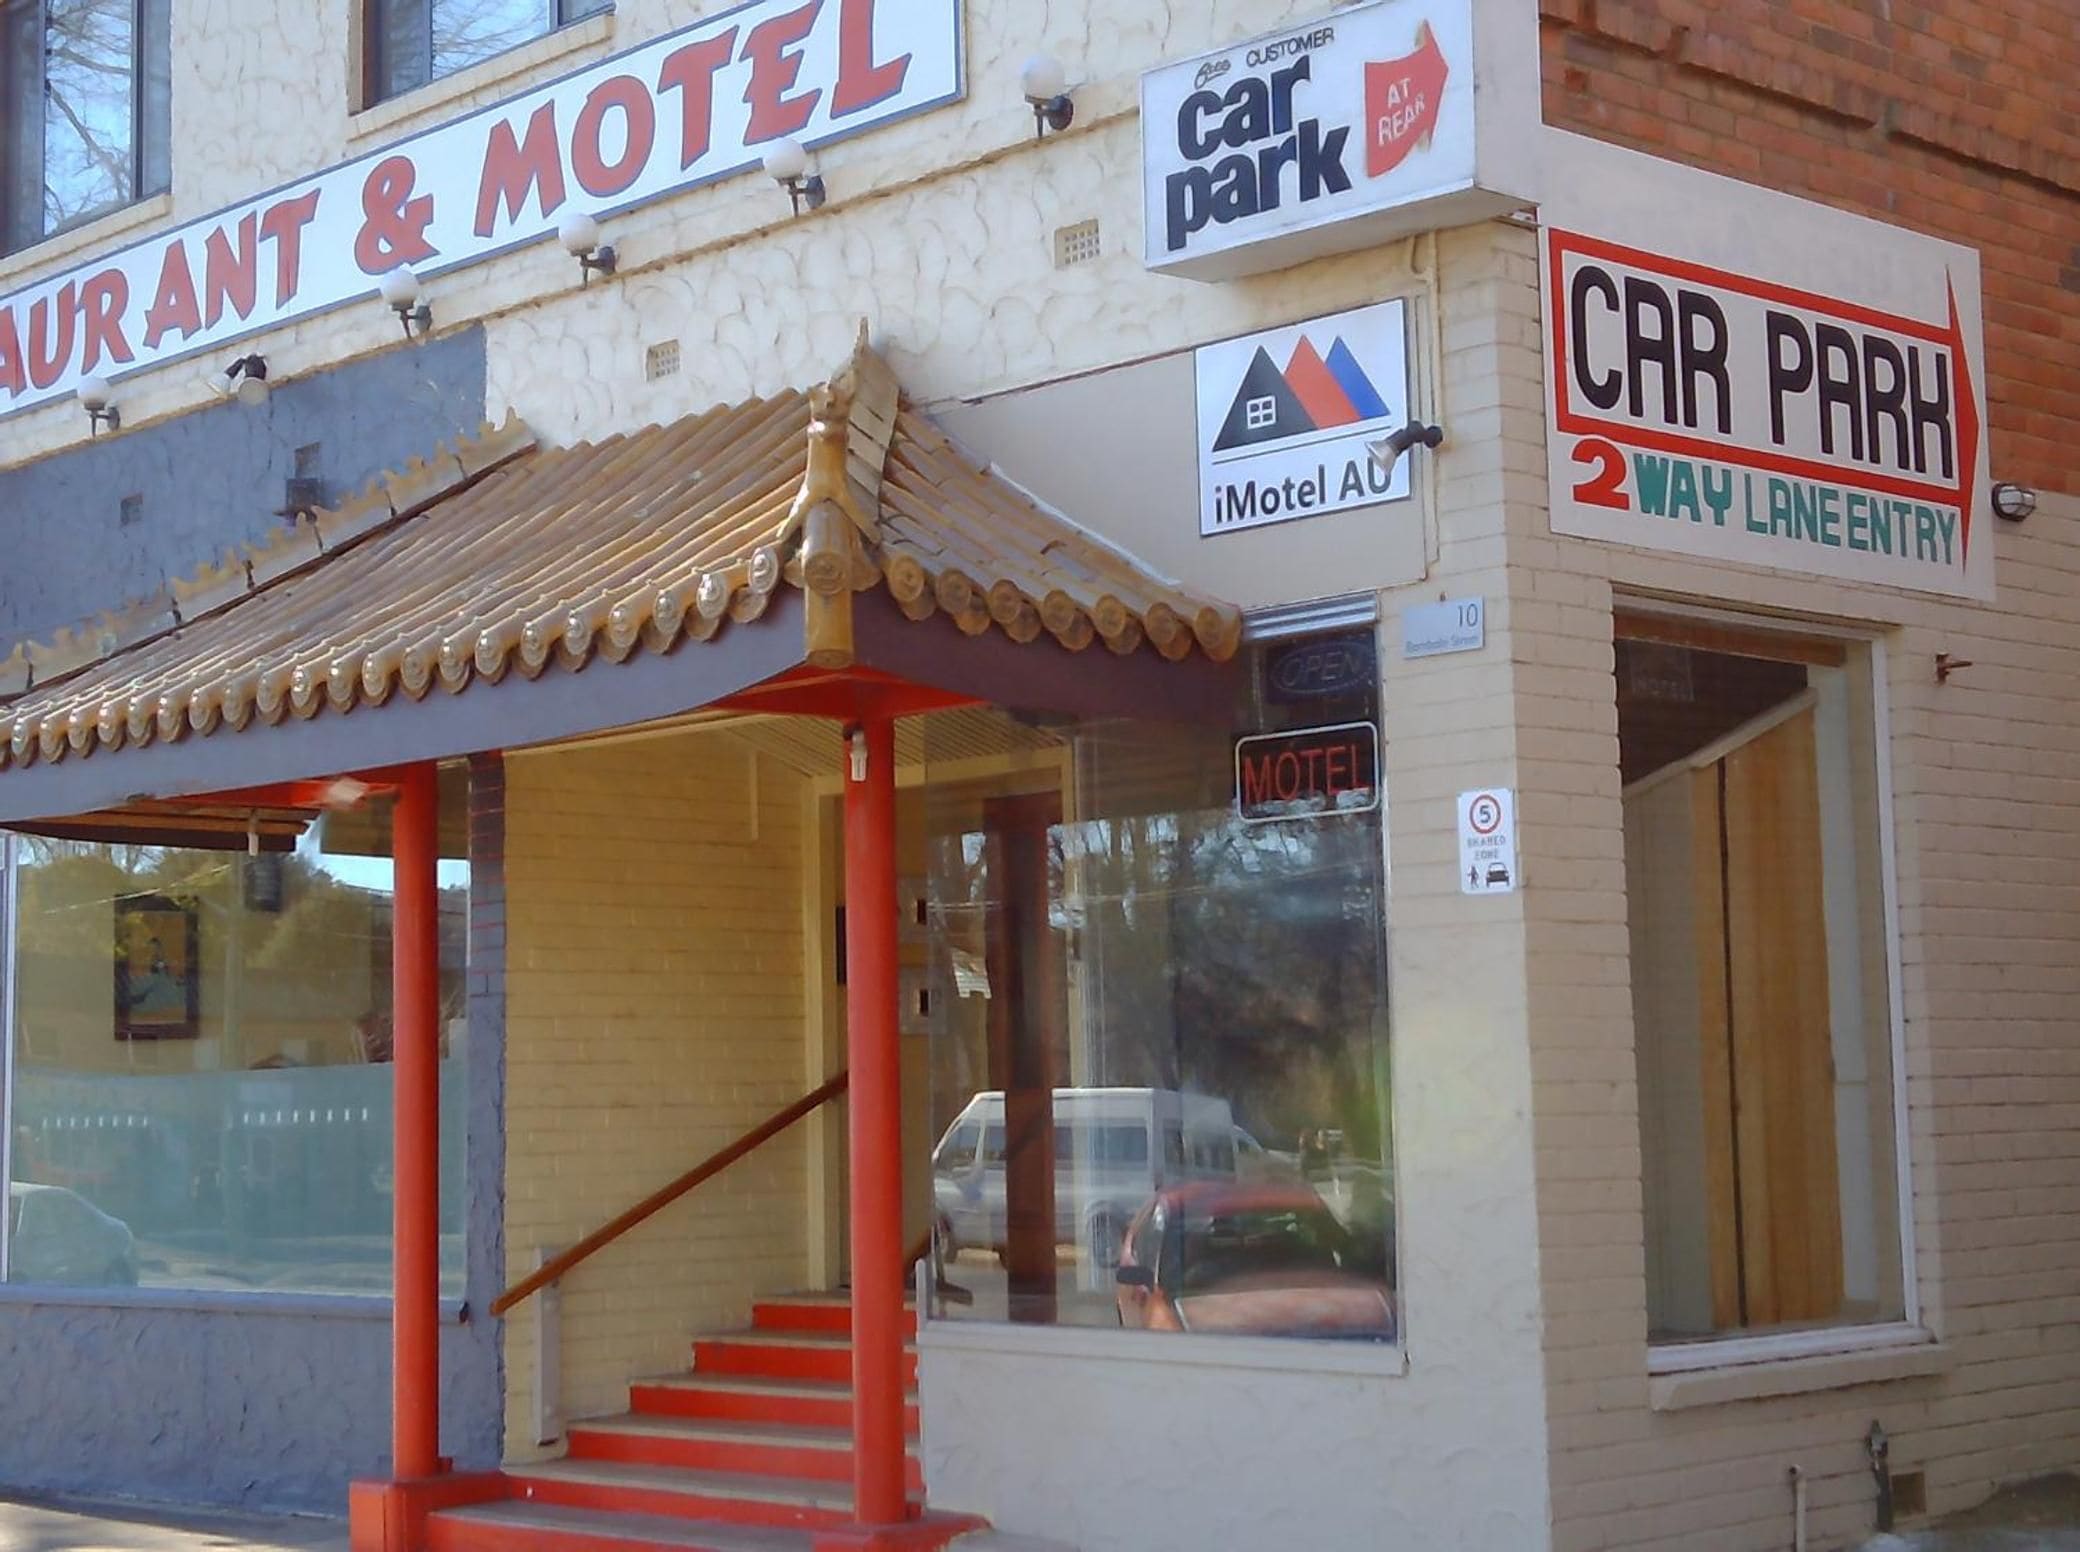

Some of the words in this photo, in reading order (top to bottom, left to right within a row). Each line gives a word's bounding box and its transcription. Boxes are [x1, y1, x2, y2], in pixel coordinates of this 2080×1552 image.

[1245, 27, 1334, 68] CUSTOMER
[1178, 55, 1311, 160] car
[1379, 92, 1425, 147] REAR
[1388, 78, 1411, 109] AT
[354, 155, 439, 274] &
[474, 0, 912, 238] MOTEL
[1166, 118, 1352, 251] park
[1571, 265, 1732, 434] CAR
[1766, 310, 1953, 479] PARK
[1215, 463, 1326, 524] iMotel
[1339, 457, 1392, 500] AU
[1571, 438, 1630, 511] 2
[1633, 453, 1732, 527] WAY
[1744, 472, 1841, 547] LANE
[1847, 493, 1956, 565] ENTRY
[1458, 603, 1478, 627] 10
[1244, 744, 1370, 804] MOTEL
[1480, 805, 1491, 824] 5
